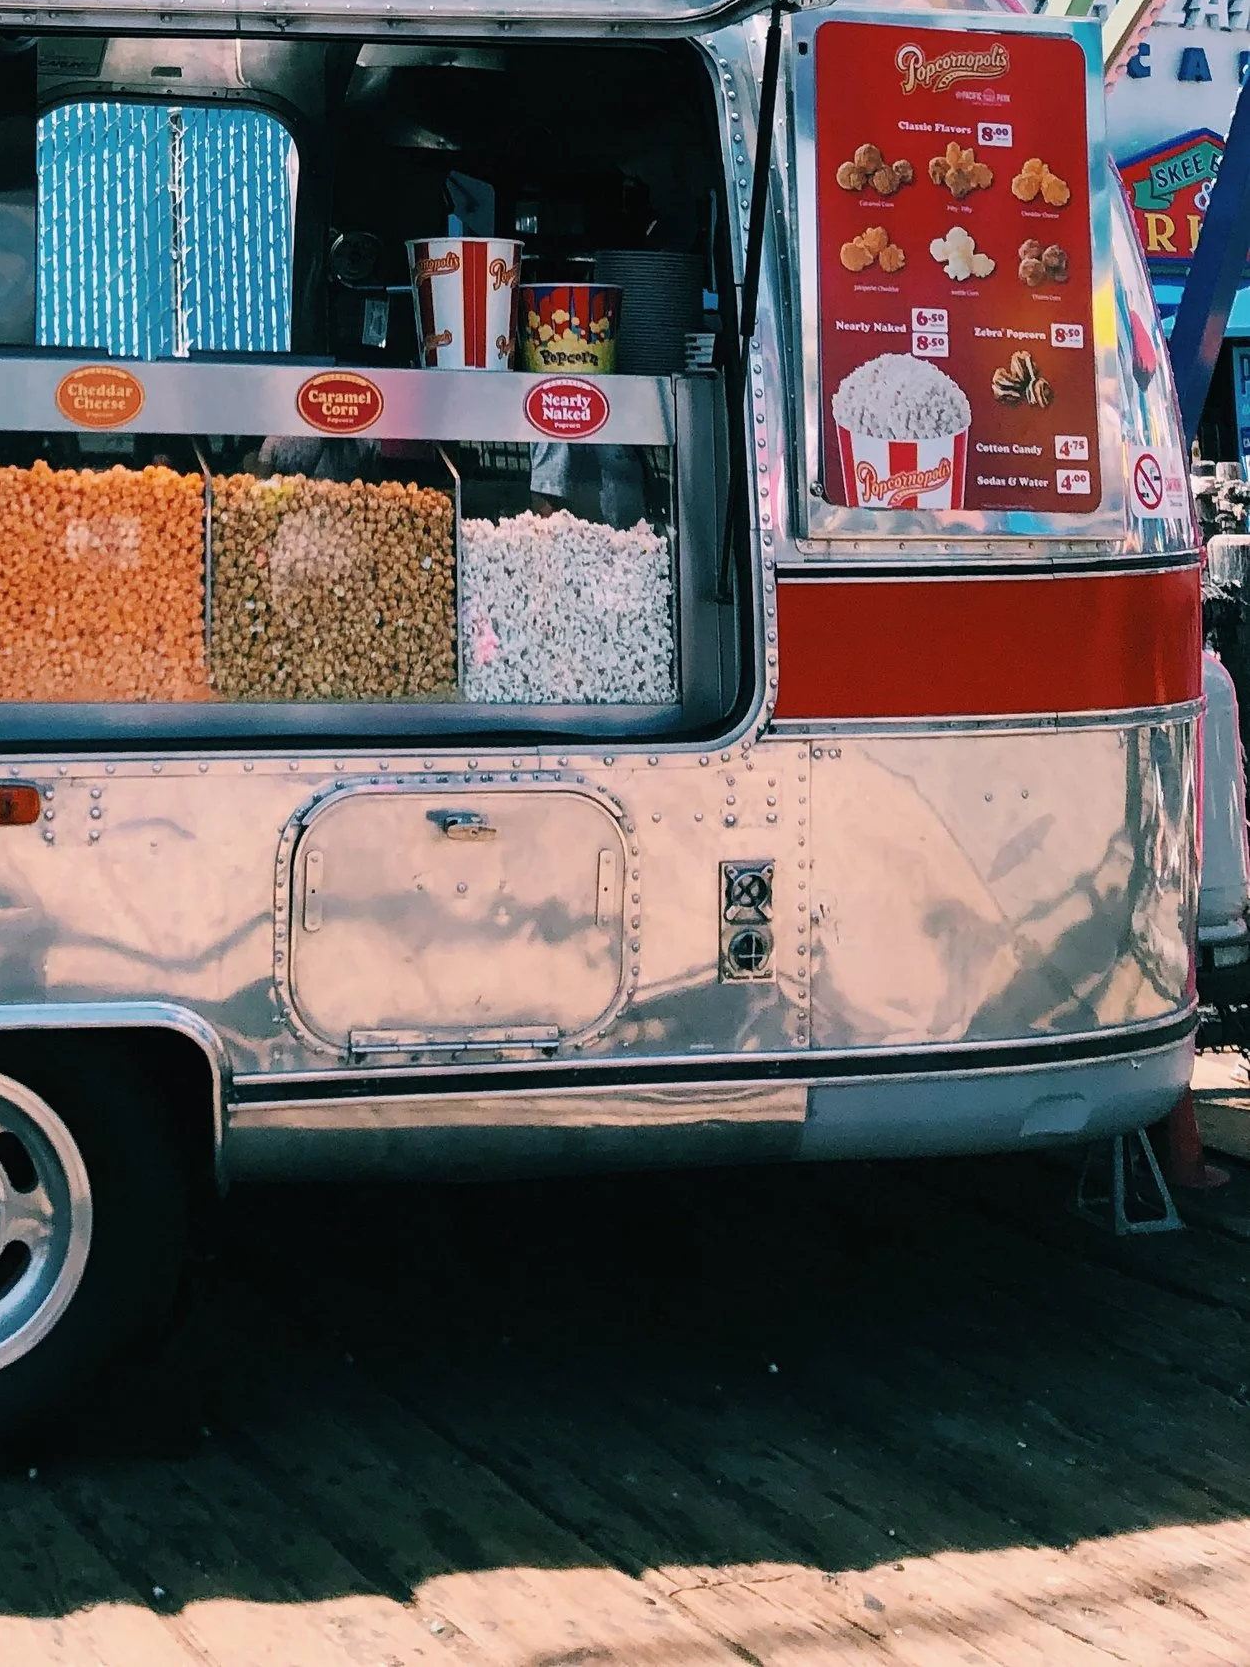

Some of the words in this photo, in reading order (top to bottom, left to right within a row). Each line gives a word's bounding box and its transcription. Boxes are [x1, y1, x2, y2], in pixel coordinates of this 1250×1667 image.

[894, 42, 1010, 94] Popcornopolis
[897, 120, 932, 132] Classic
[934, 123, 972, 134] Flavors
[981, 126, 1010, 142] 8.00
[1155, 152, 1205, 189] SKEE
[835, 320, 871, 333] Nearly
[873, 322, 907, 333] Naked
[916, 310, 945, 327] 6.50
[1006, 328, 1047, 340] Popcorn
[1055, 327, 1081, 343] 8.50
[916, 335, 945, 351] 8.50
[67, 382, 134, 398] Cheddar
[307, 389, 372, 405] Caramel
[73, 396, 127, 410] Cheese
[541, 392, 592, 410] Nearly
[321, 403, 359, 416] Corn
[542, 407, 591, 421] Naked
[975, 442, 1010, 454] Cotton
[1012, 444, 1043, 456] Candy
[1059, 440, 1085, 457] 4.75
[856, 457, 951, 506] Popcornopolis
[977, 475, 1006, 486] Sodas
[1007, 476, 1017, 487] &
[1018, 477, 1049, 488] Water
[1060, 474, 1087, 491] 4.00
